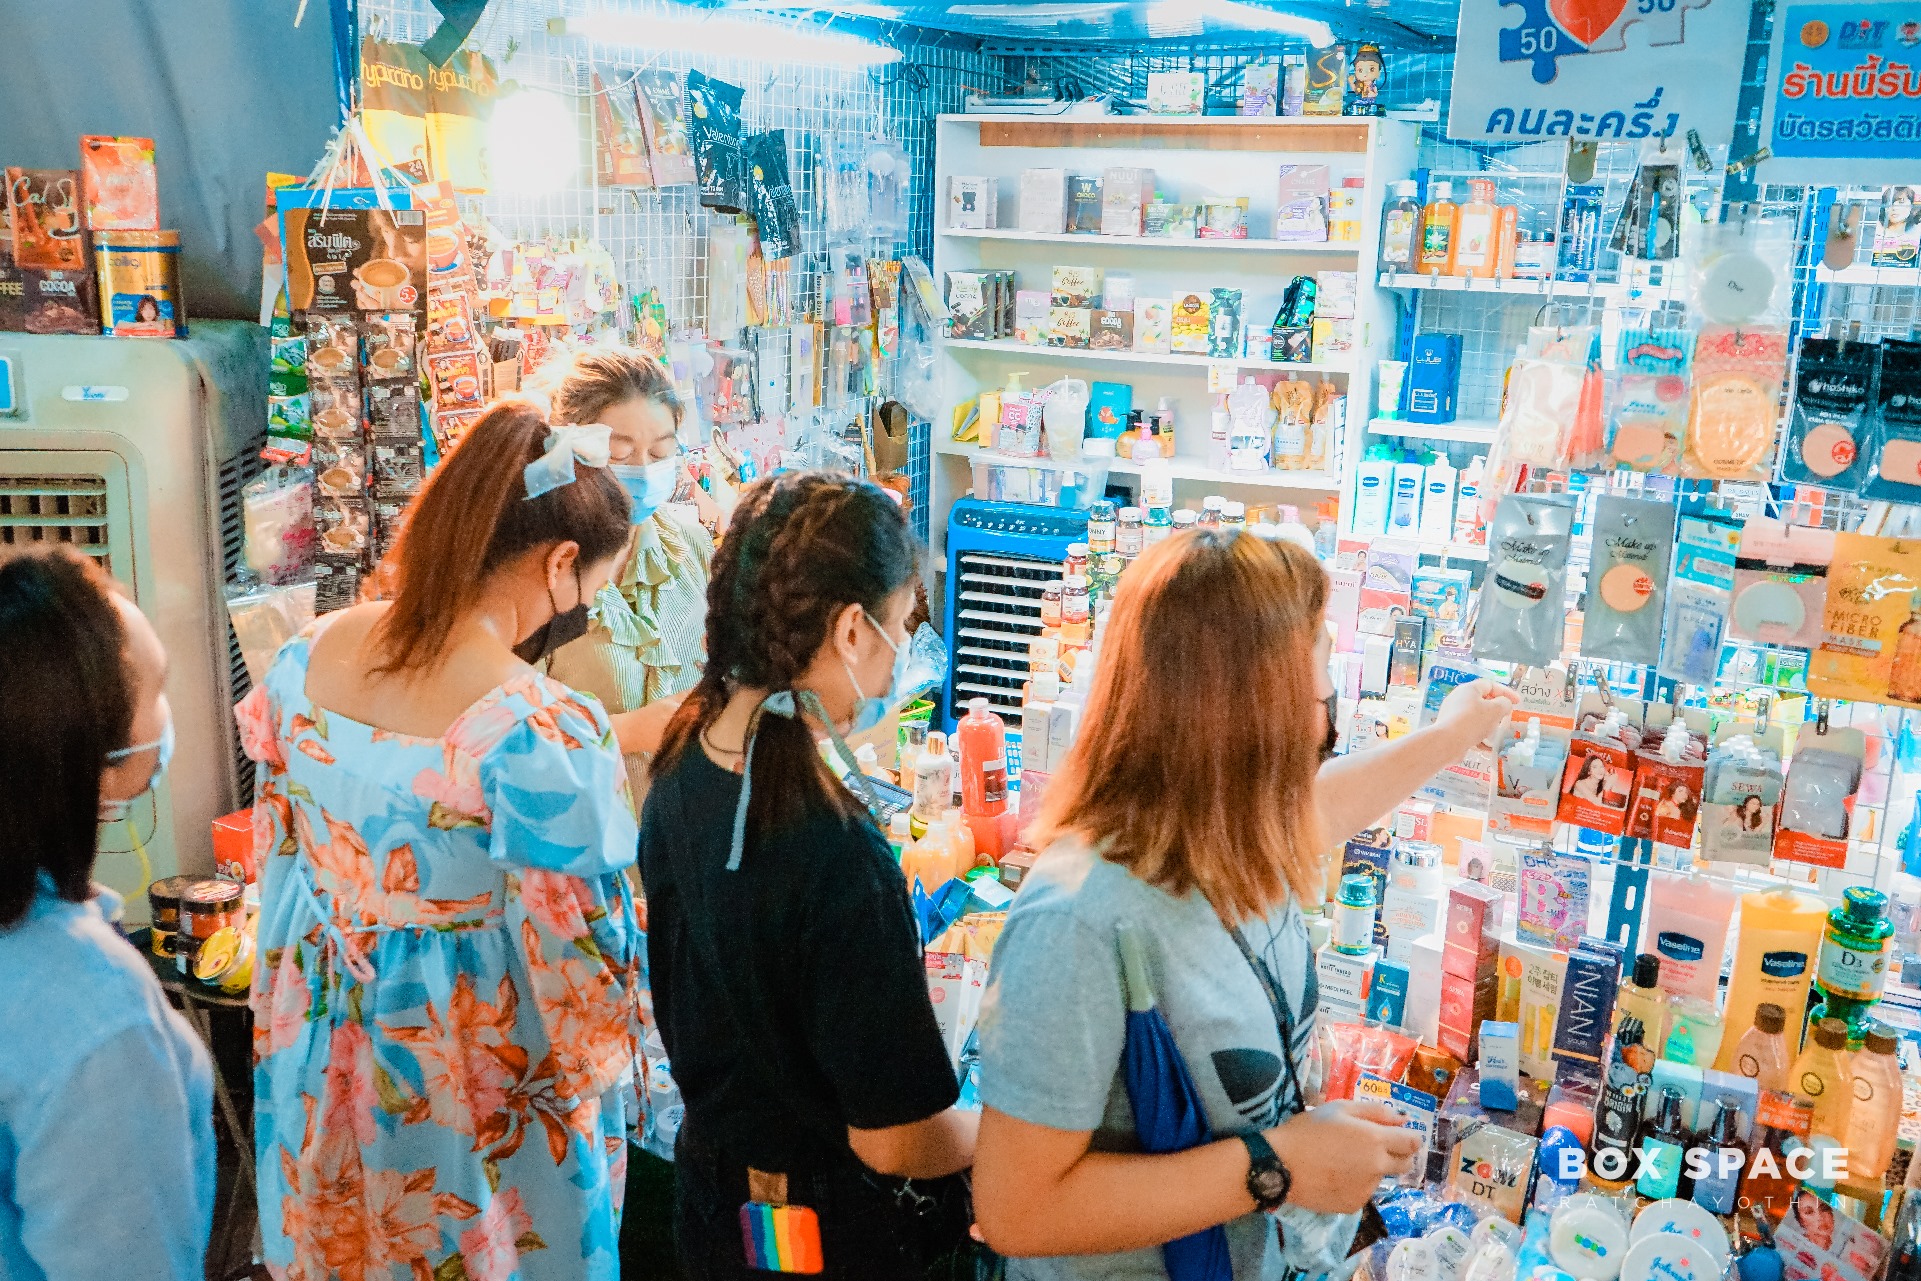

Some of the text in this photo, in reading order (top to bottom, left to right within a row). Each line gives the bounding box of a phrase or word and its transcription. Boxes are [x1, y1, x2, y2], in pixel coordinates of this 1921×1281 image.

[1520, 26, 1557, 54] 50
[1485, 86, 1681, 139] คนละครึ่ง
[1779, 112, 1921, 140] บัตรสวัสดิ
[1605, 536, 1641, 551] Make
[1833, 610, 1882, 626] MICRO
[1396, 639, 1417, 649] HYA
[1433, 666, 1465, 684] DHC
[1521, 683, 1551, 698] สว่าง
[1730, 780, 1763, 793] SEWA
[1523, 855, 1559, 869] DHC
[1659, 936, 1701, 954] Vaseline
[1764, 957, 1806, 969] Vaseline
[1471, 1181, 1497, 1199] DT
